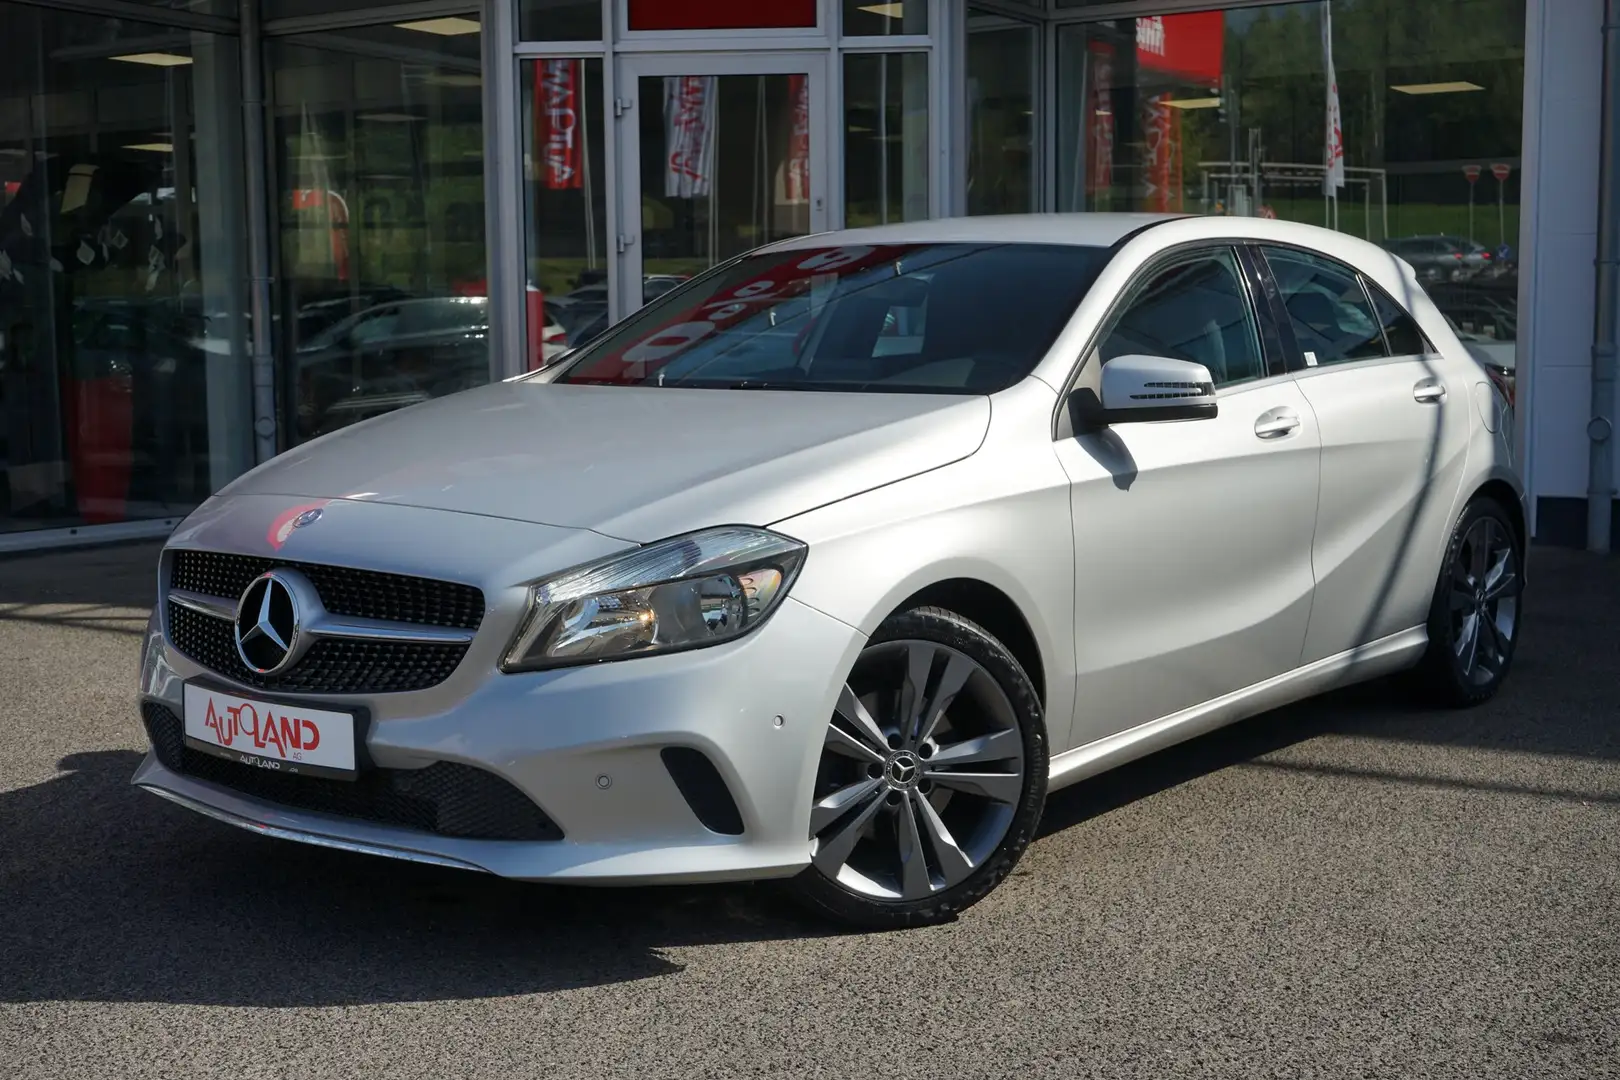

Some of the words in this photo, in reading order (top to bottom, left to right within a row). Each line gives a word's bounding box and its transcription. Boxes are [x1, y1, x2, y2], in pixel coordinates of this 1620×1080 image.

[204, 697, 320, 758] AUTOLAND
[239, 754, 281, 770] AUTOLAND
[292, 751, 302, 761] AG
